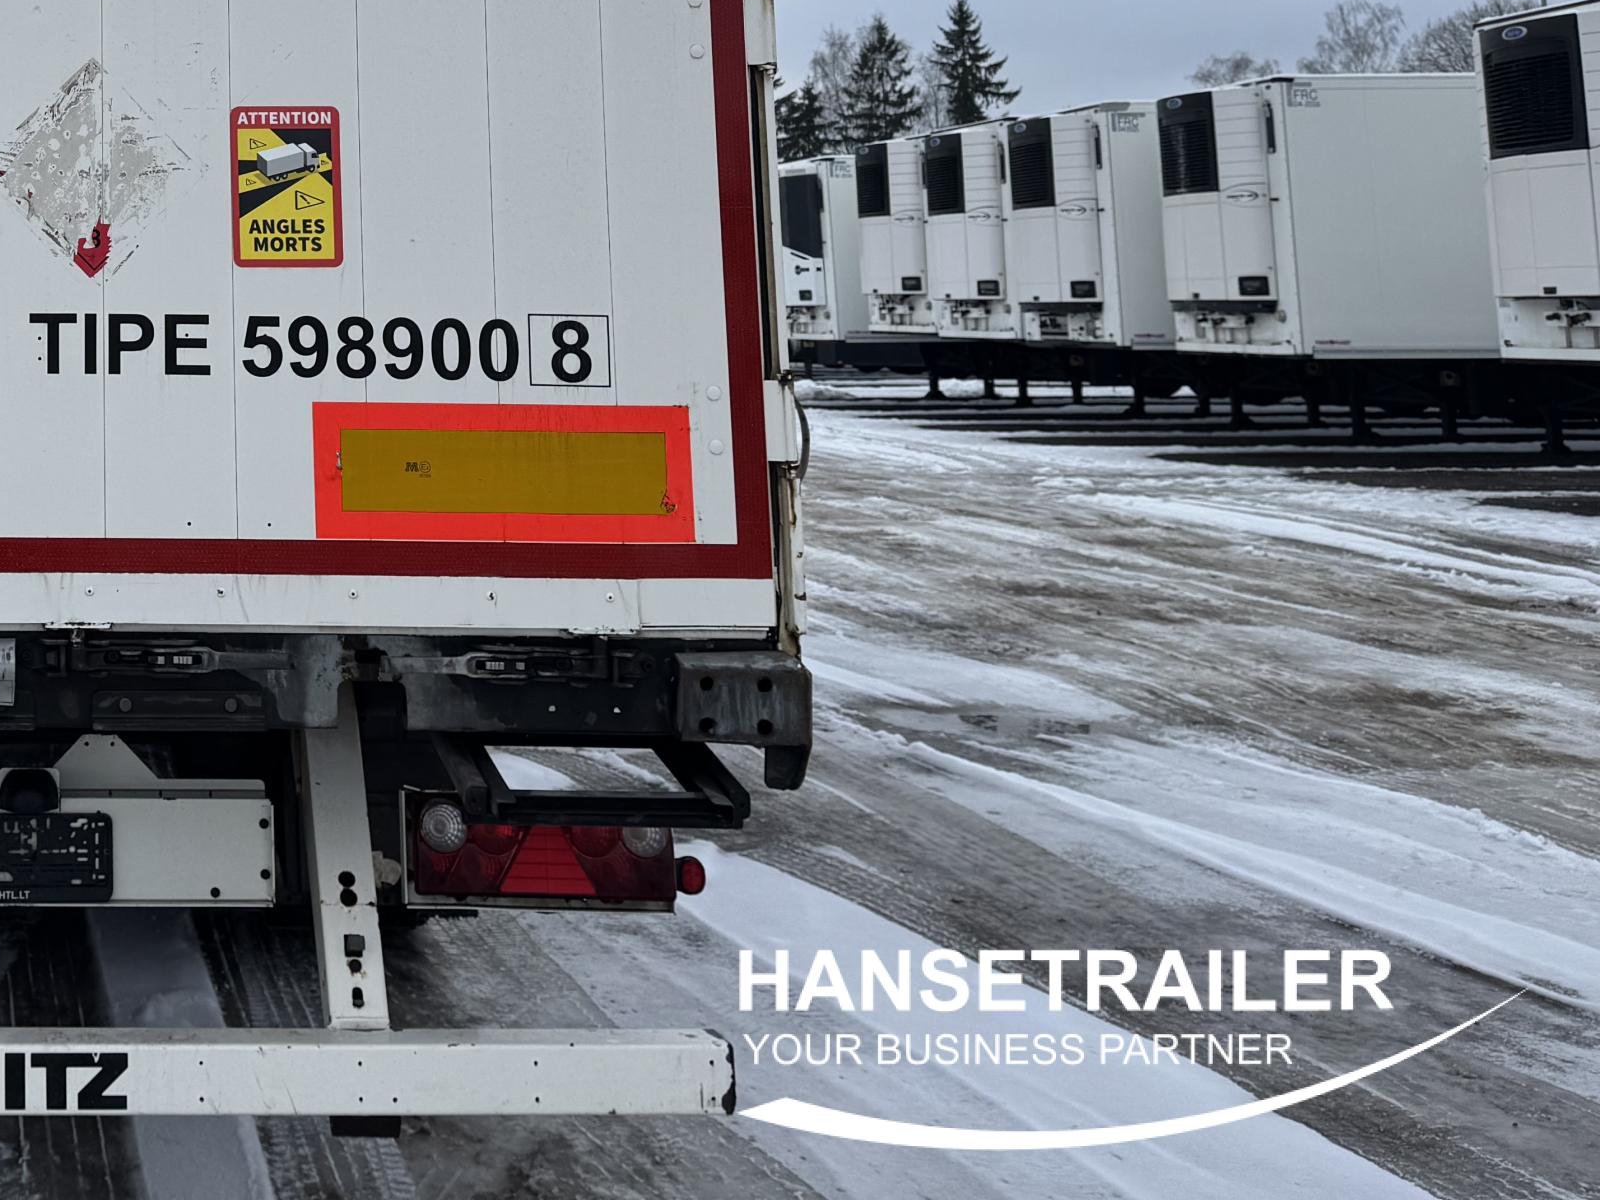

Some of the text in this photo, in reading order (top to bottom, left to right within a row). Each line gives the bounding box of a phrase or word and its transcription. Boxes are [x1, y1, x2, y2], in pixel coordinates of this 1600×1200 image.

[1294, 89, 1318, 100] FRC
[237, 111, 332, 125] ATTENTION
[249, 219, 326, 235] ANGLES
[253, 236, 323, 252] MORTS
[29, 312, 593, 384] TIPE 598900 8
